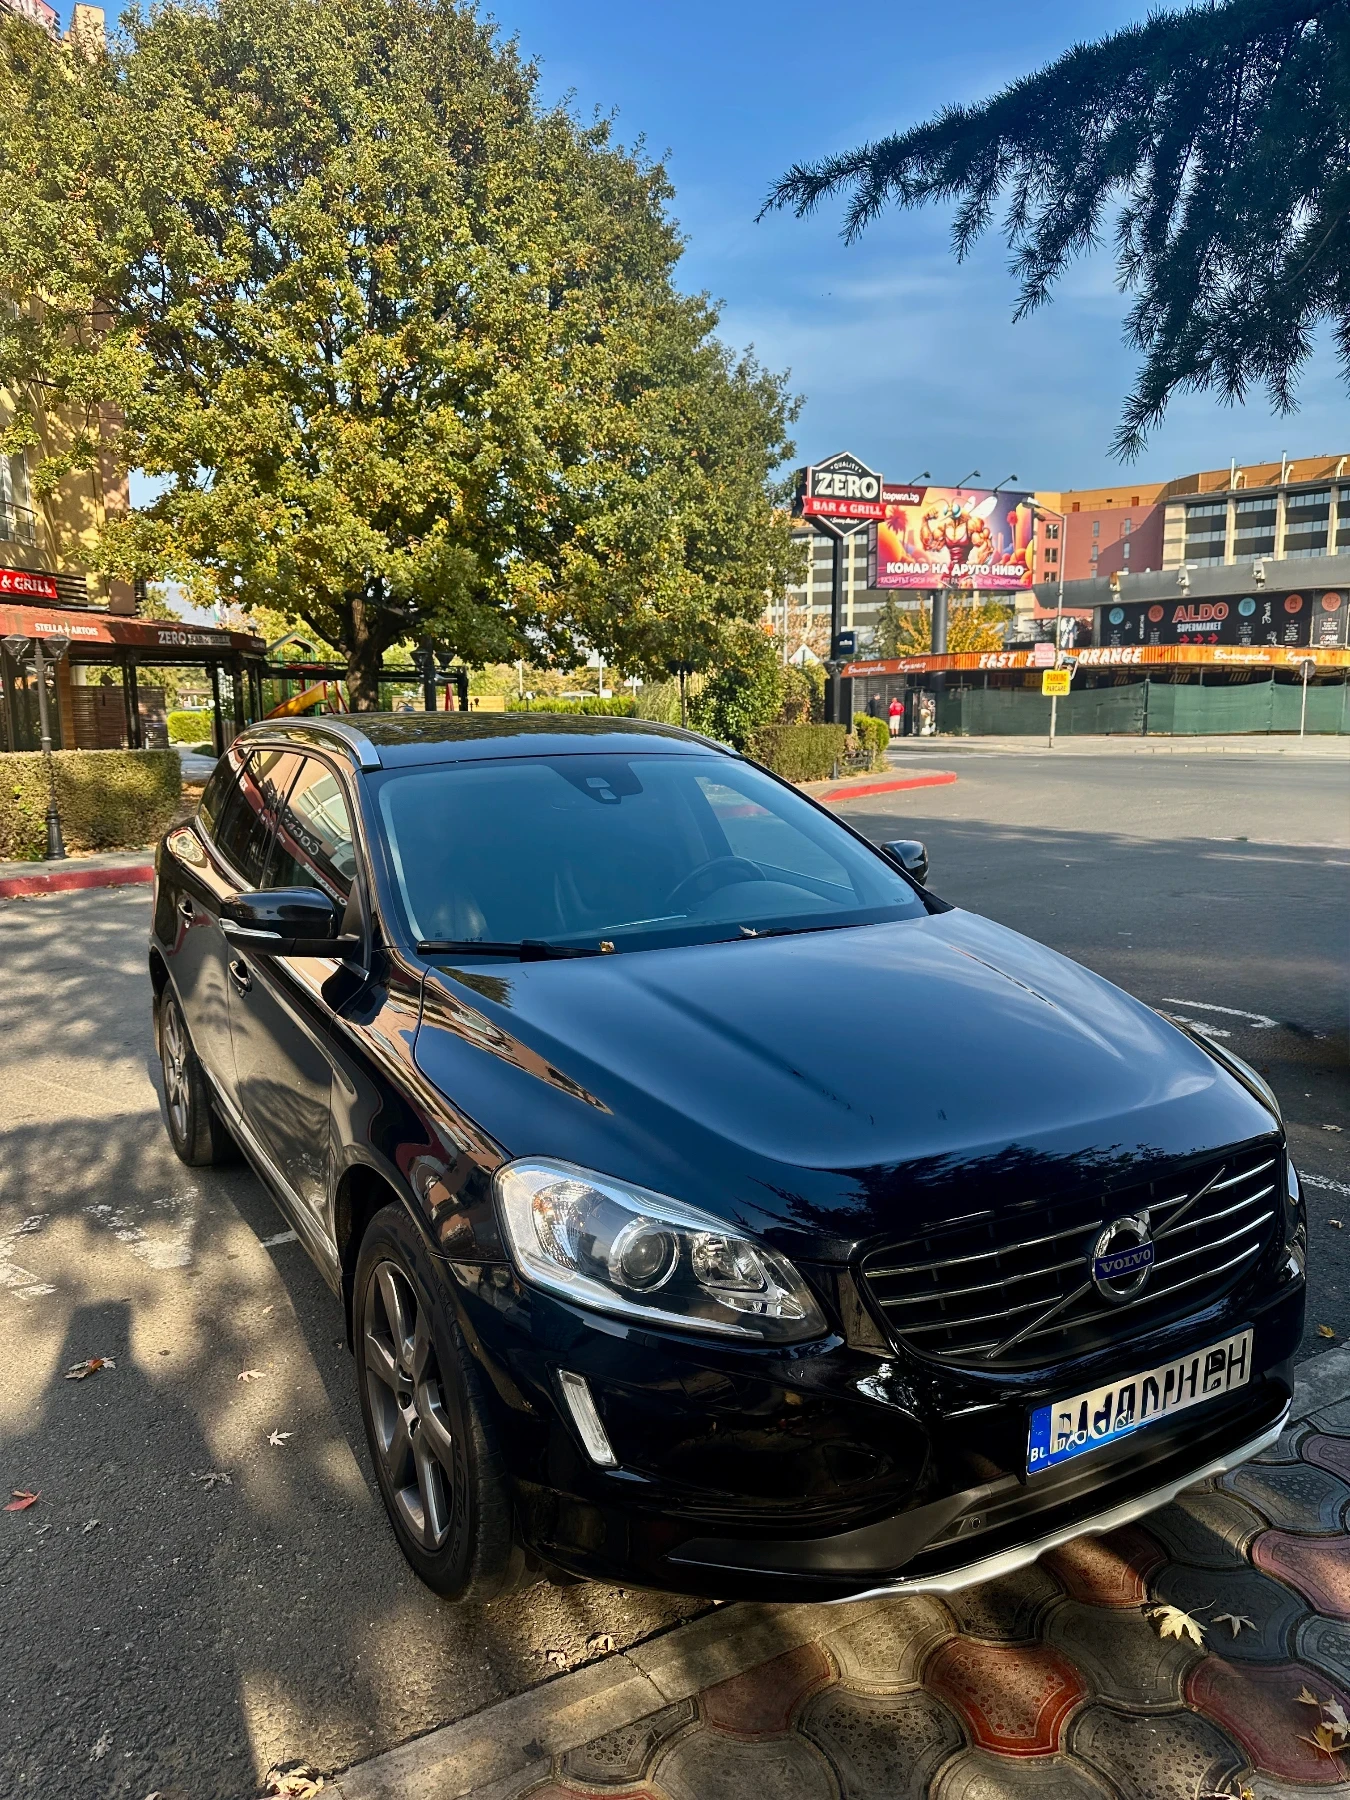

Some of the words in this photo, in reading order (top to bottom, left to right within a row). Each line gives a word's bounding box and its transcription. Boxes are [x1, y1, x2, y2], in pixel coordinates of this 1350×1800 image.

[833, 461, 860, 471] QUALITY
[816, 473, 878, 499] ZERO
[813, 501, 836, 511] BAR
[838, 503, 847, 513] &
[849, 504, 882, 515] GRILL
[886, 562, 929, 574] КОМАР
[932, 563, 949, 574] НА
[951, 564, 990, 576] ДРУГО
[991, 565, 1025, 576] НИВО
[1, 575, 11, 588] &
[14, 577, 52, 593] GRILL
[1172, 602, 1229, 623] ALDO
[34, 623, 64, 632] STELLA
[71, 626, 98, 636] ARTOIS
[1177, 621, 1222, 633] SUPERMARKET
[158, 631, 186, 645] ZERO
[979, 653, 1018, 669] FAST
[1025, 651, 1065, 668] FD
[1078, 648, 1144, 665] ORANGE
[1046, 673, 1067, 682] PARKING
[1099, 1249, 1151, 1273] VOLVO
